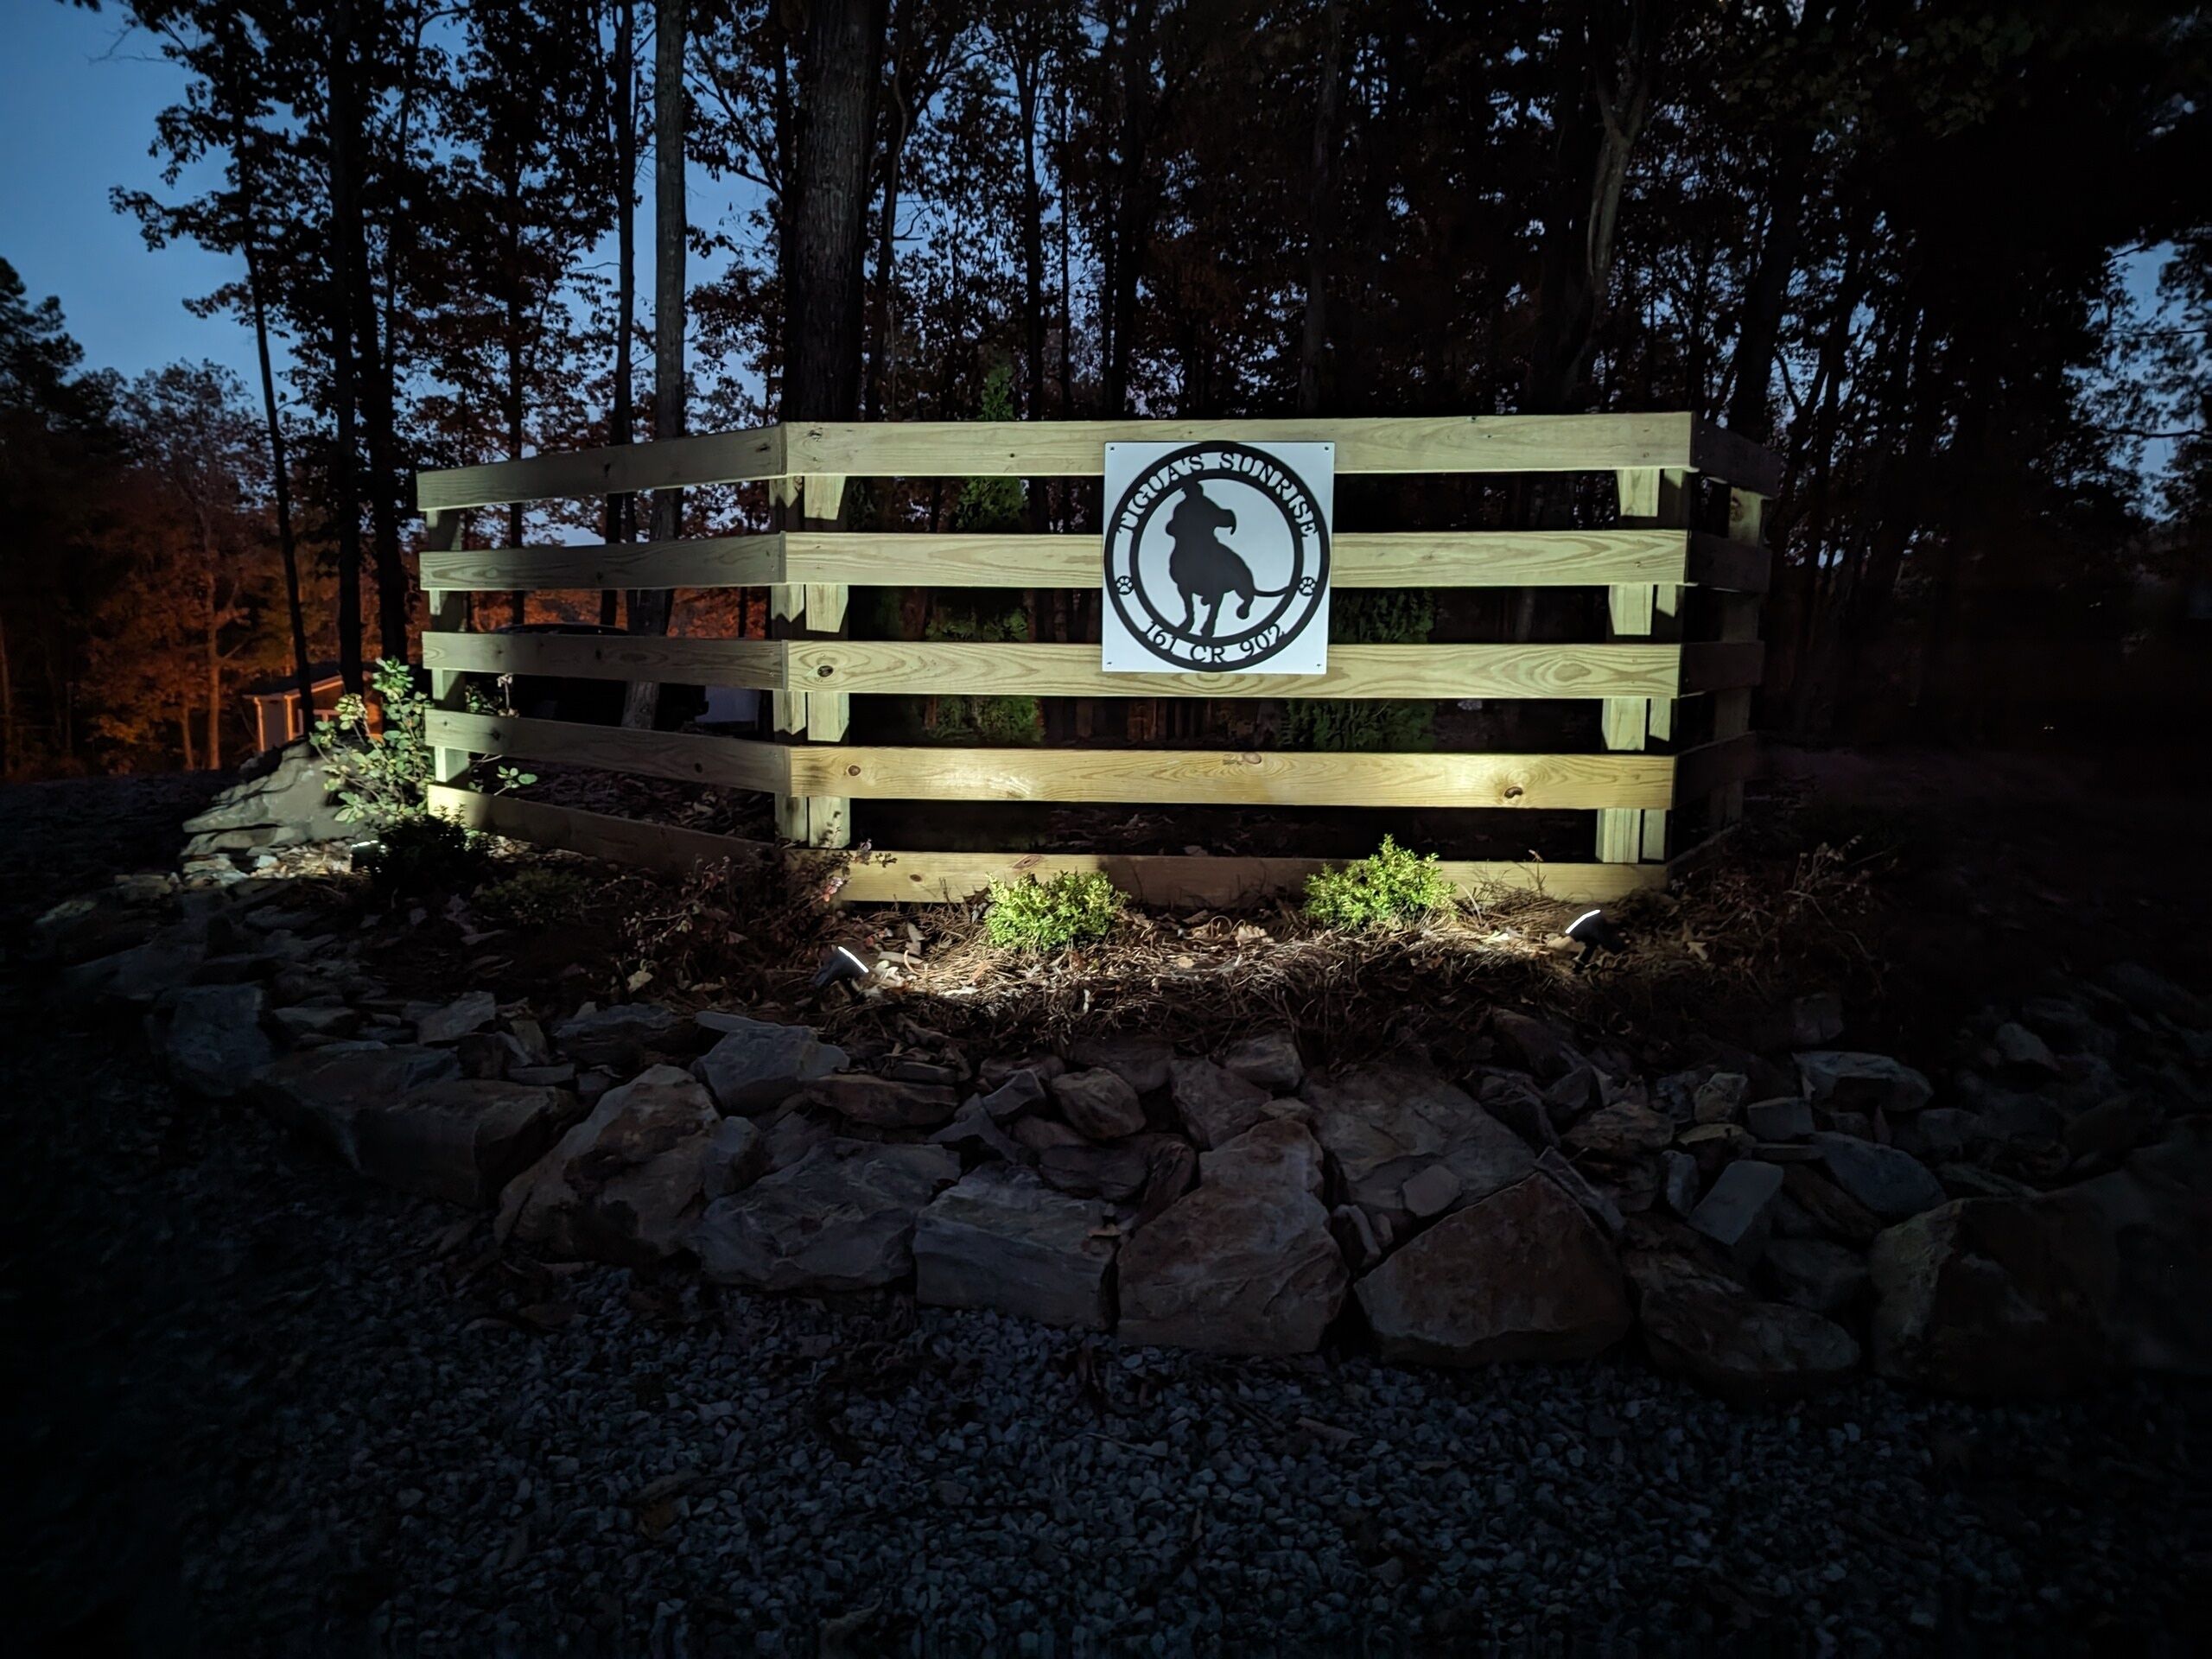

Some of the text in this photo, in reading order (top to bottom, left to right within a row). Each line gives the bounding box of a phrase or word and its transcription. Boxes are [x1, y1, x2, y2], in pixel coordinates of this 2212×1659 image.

[1116, 452, 1318, 537] TIGUA'S SUNRISE
[1144, 620, 1284, 664] 161 CR 902
